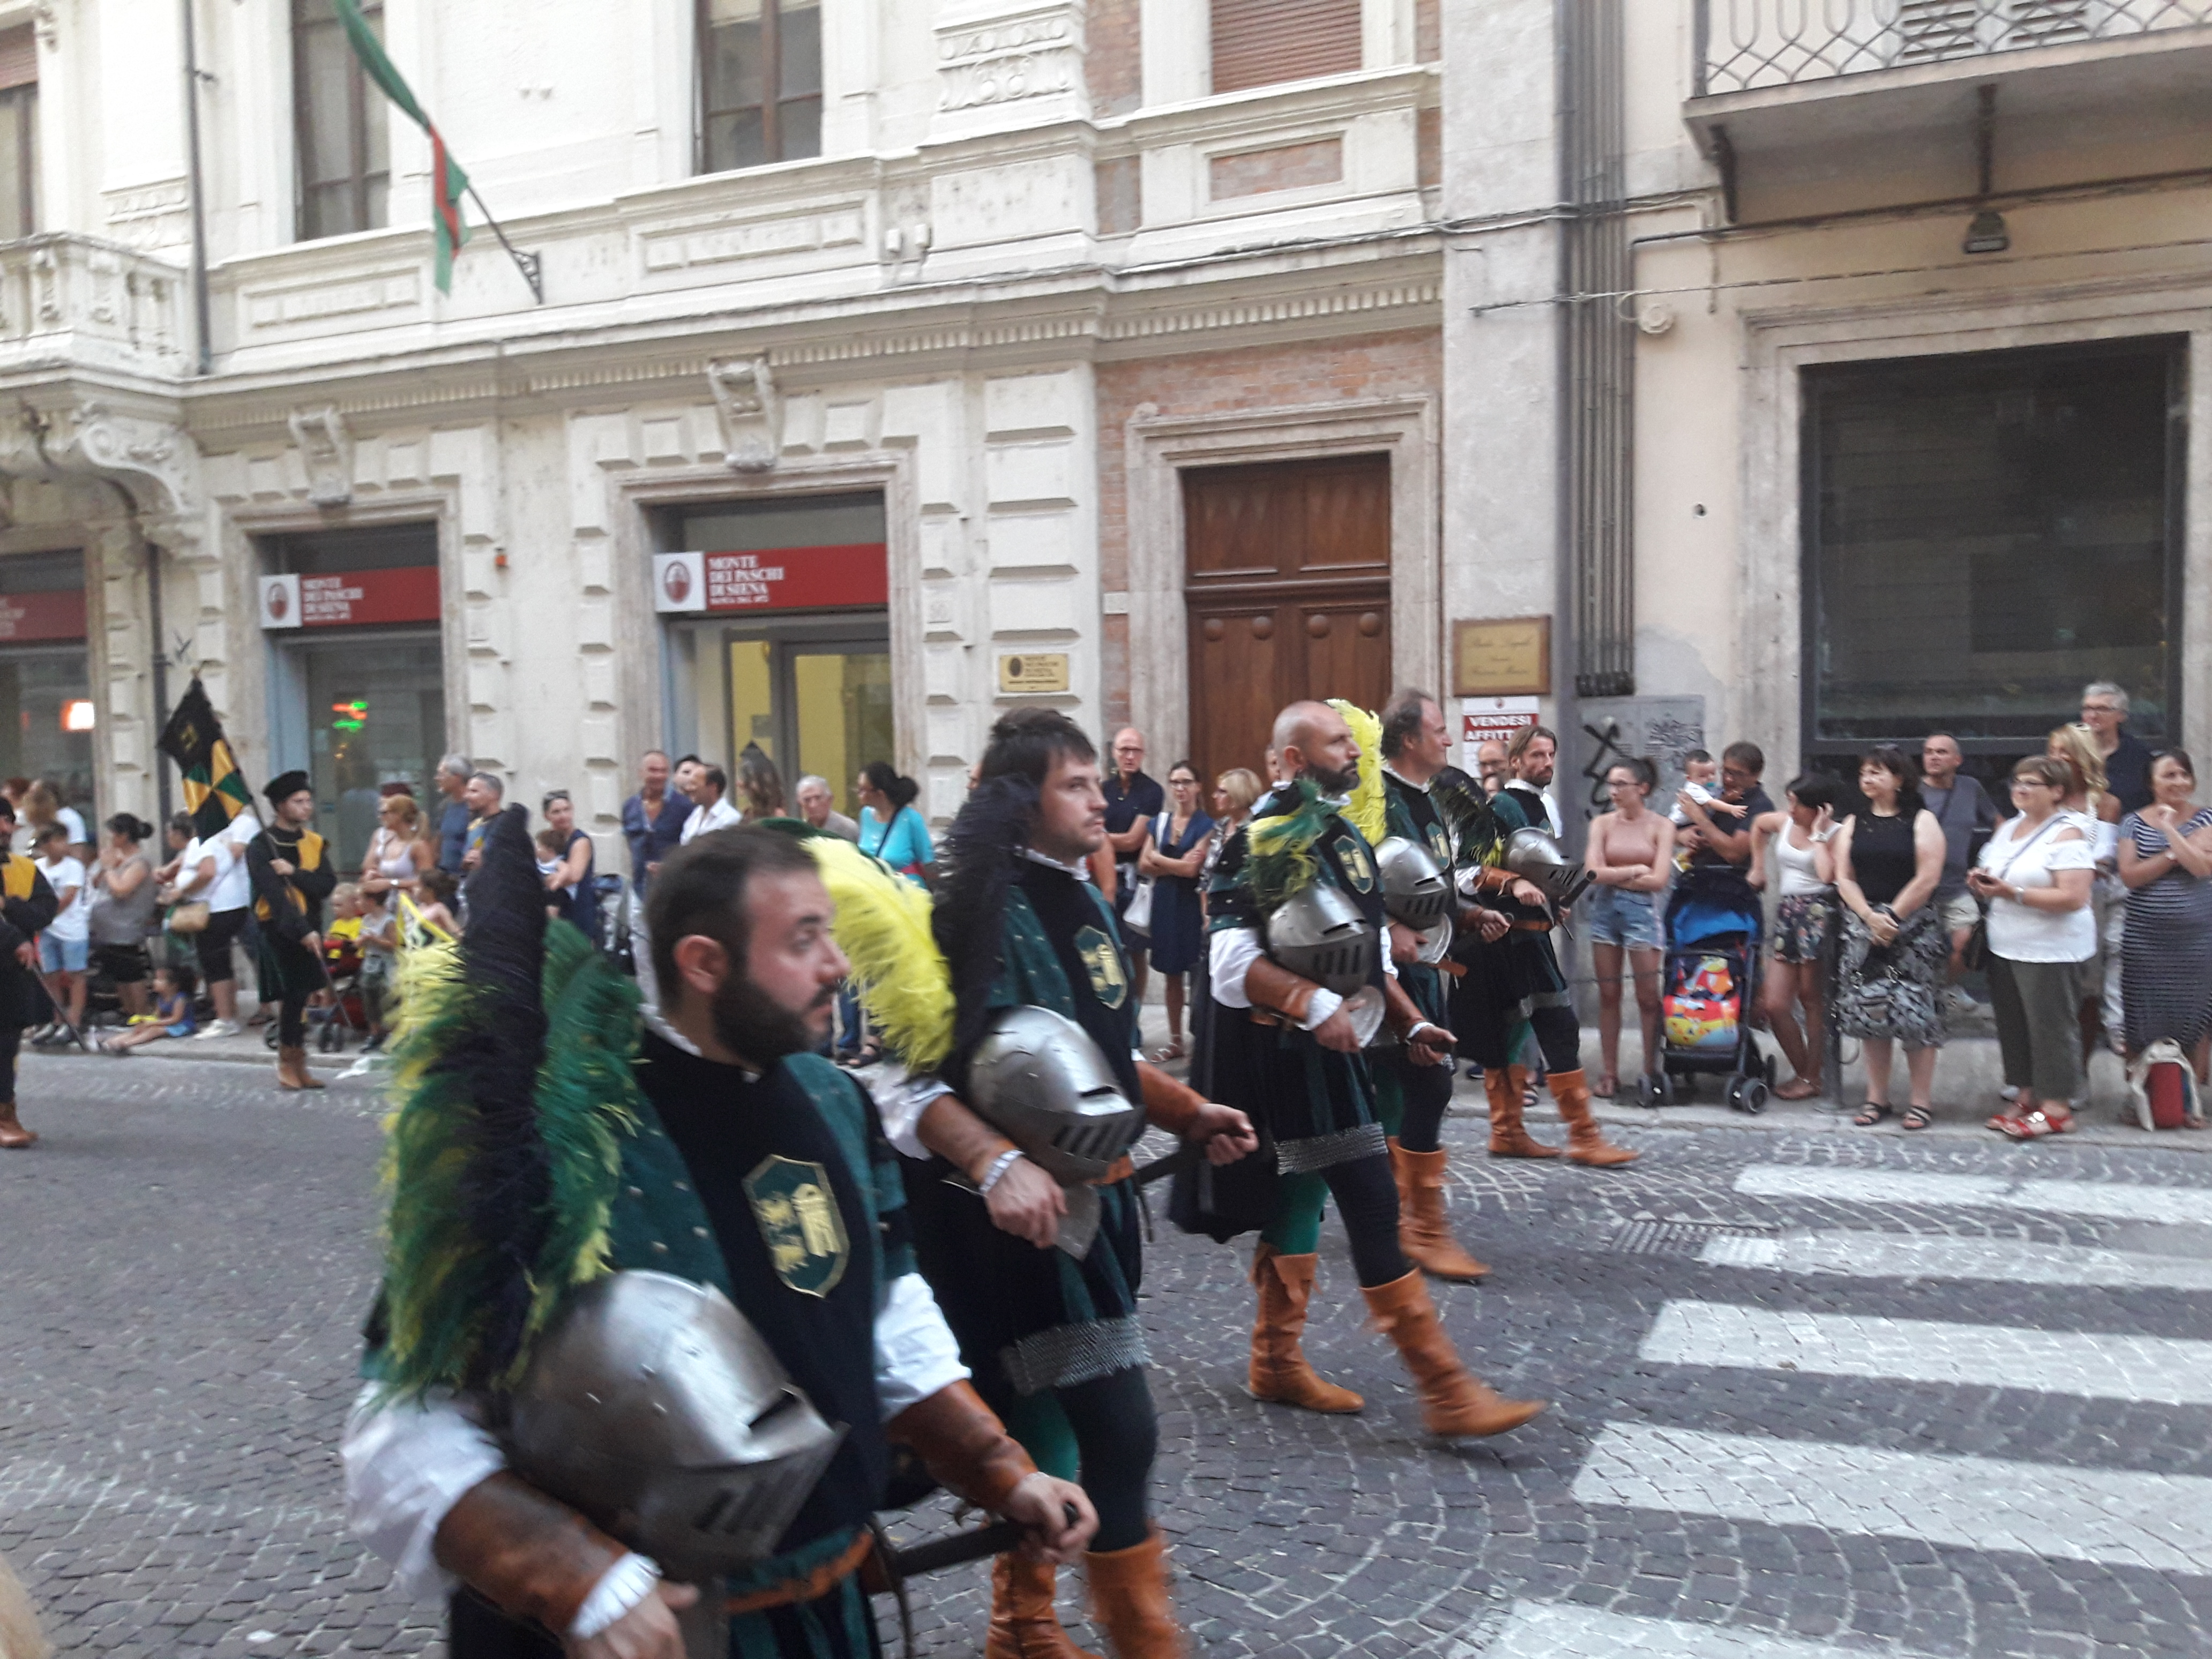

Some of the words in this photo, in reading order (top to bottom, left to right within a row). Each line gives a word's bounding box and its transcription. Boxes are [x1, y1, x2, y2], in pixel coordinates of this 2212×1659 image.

[708, 556, 757, 570] MONTE
[709, 570, 732, 584] DEI
[734, 566, 784, 582] PASCHI
[709, 584, 724, 597] DI
[726, 581, 767, 596] SIENA
[1468, 715, 1531, 727] VENDESI
[1464, 729, 1514, 741] AFFITT
